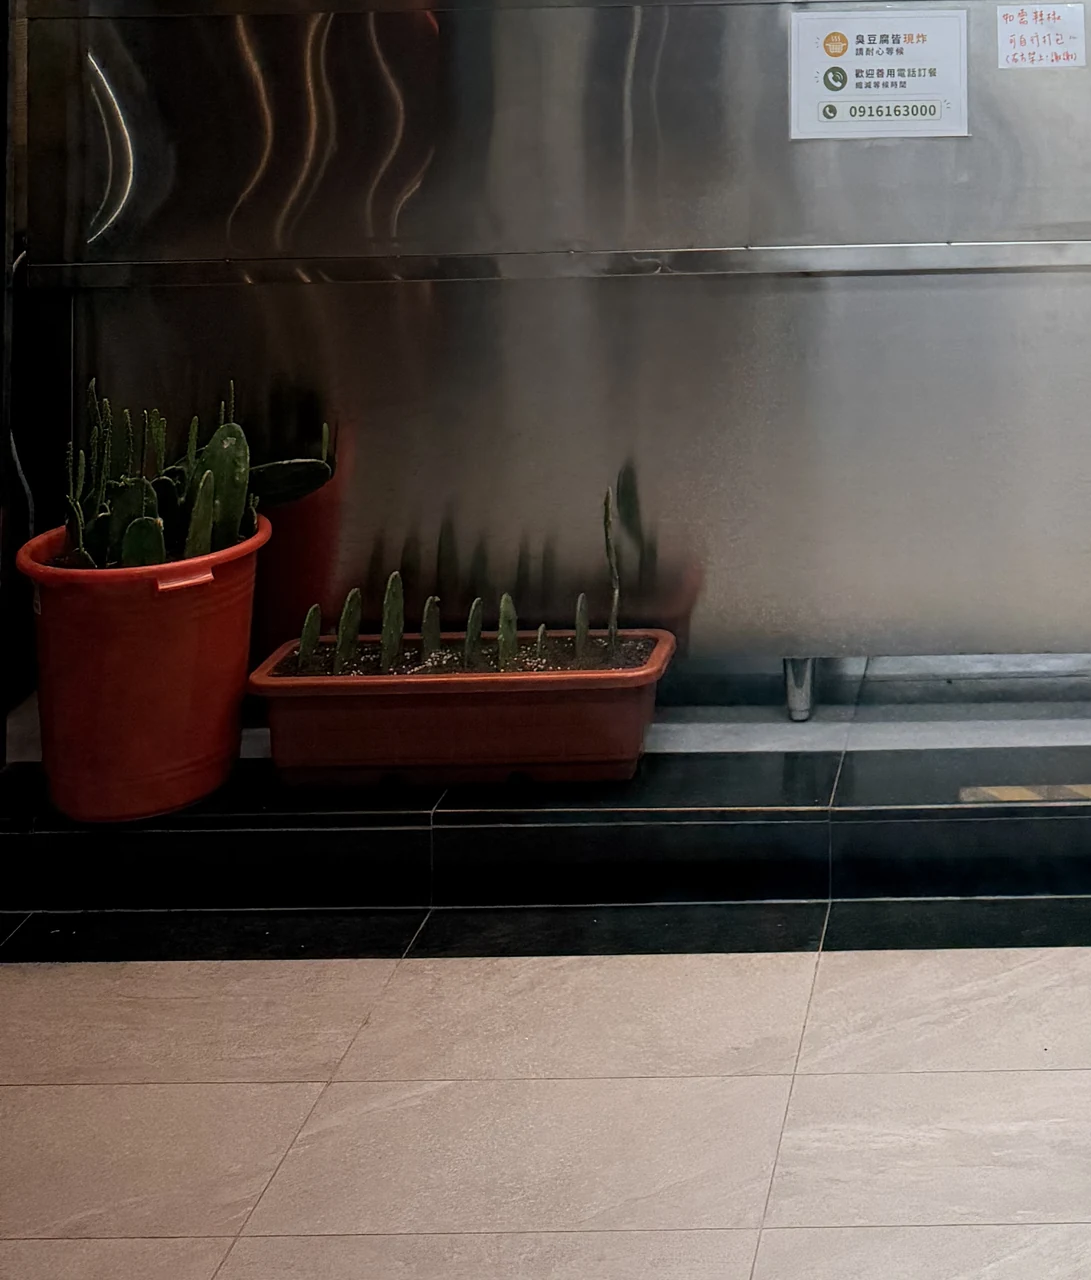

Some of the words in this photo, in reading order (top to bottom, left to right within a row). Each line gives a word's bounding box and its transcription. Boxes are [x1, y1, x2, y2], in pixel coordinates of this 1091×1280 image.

[855, 33, 928, 45] 臭豆腐皆現炸
[855, 46, 905, 56] 請耐心等候
[855, 68, 937, 79] 歡迎善用電話訂餐
[849, 104, 937, 118] 0916163000
